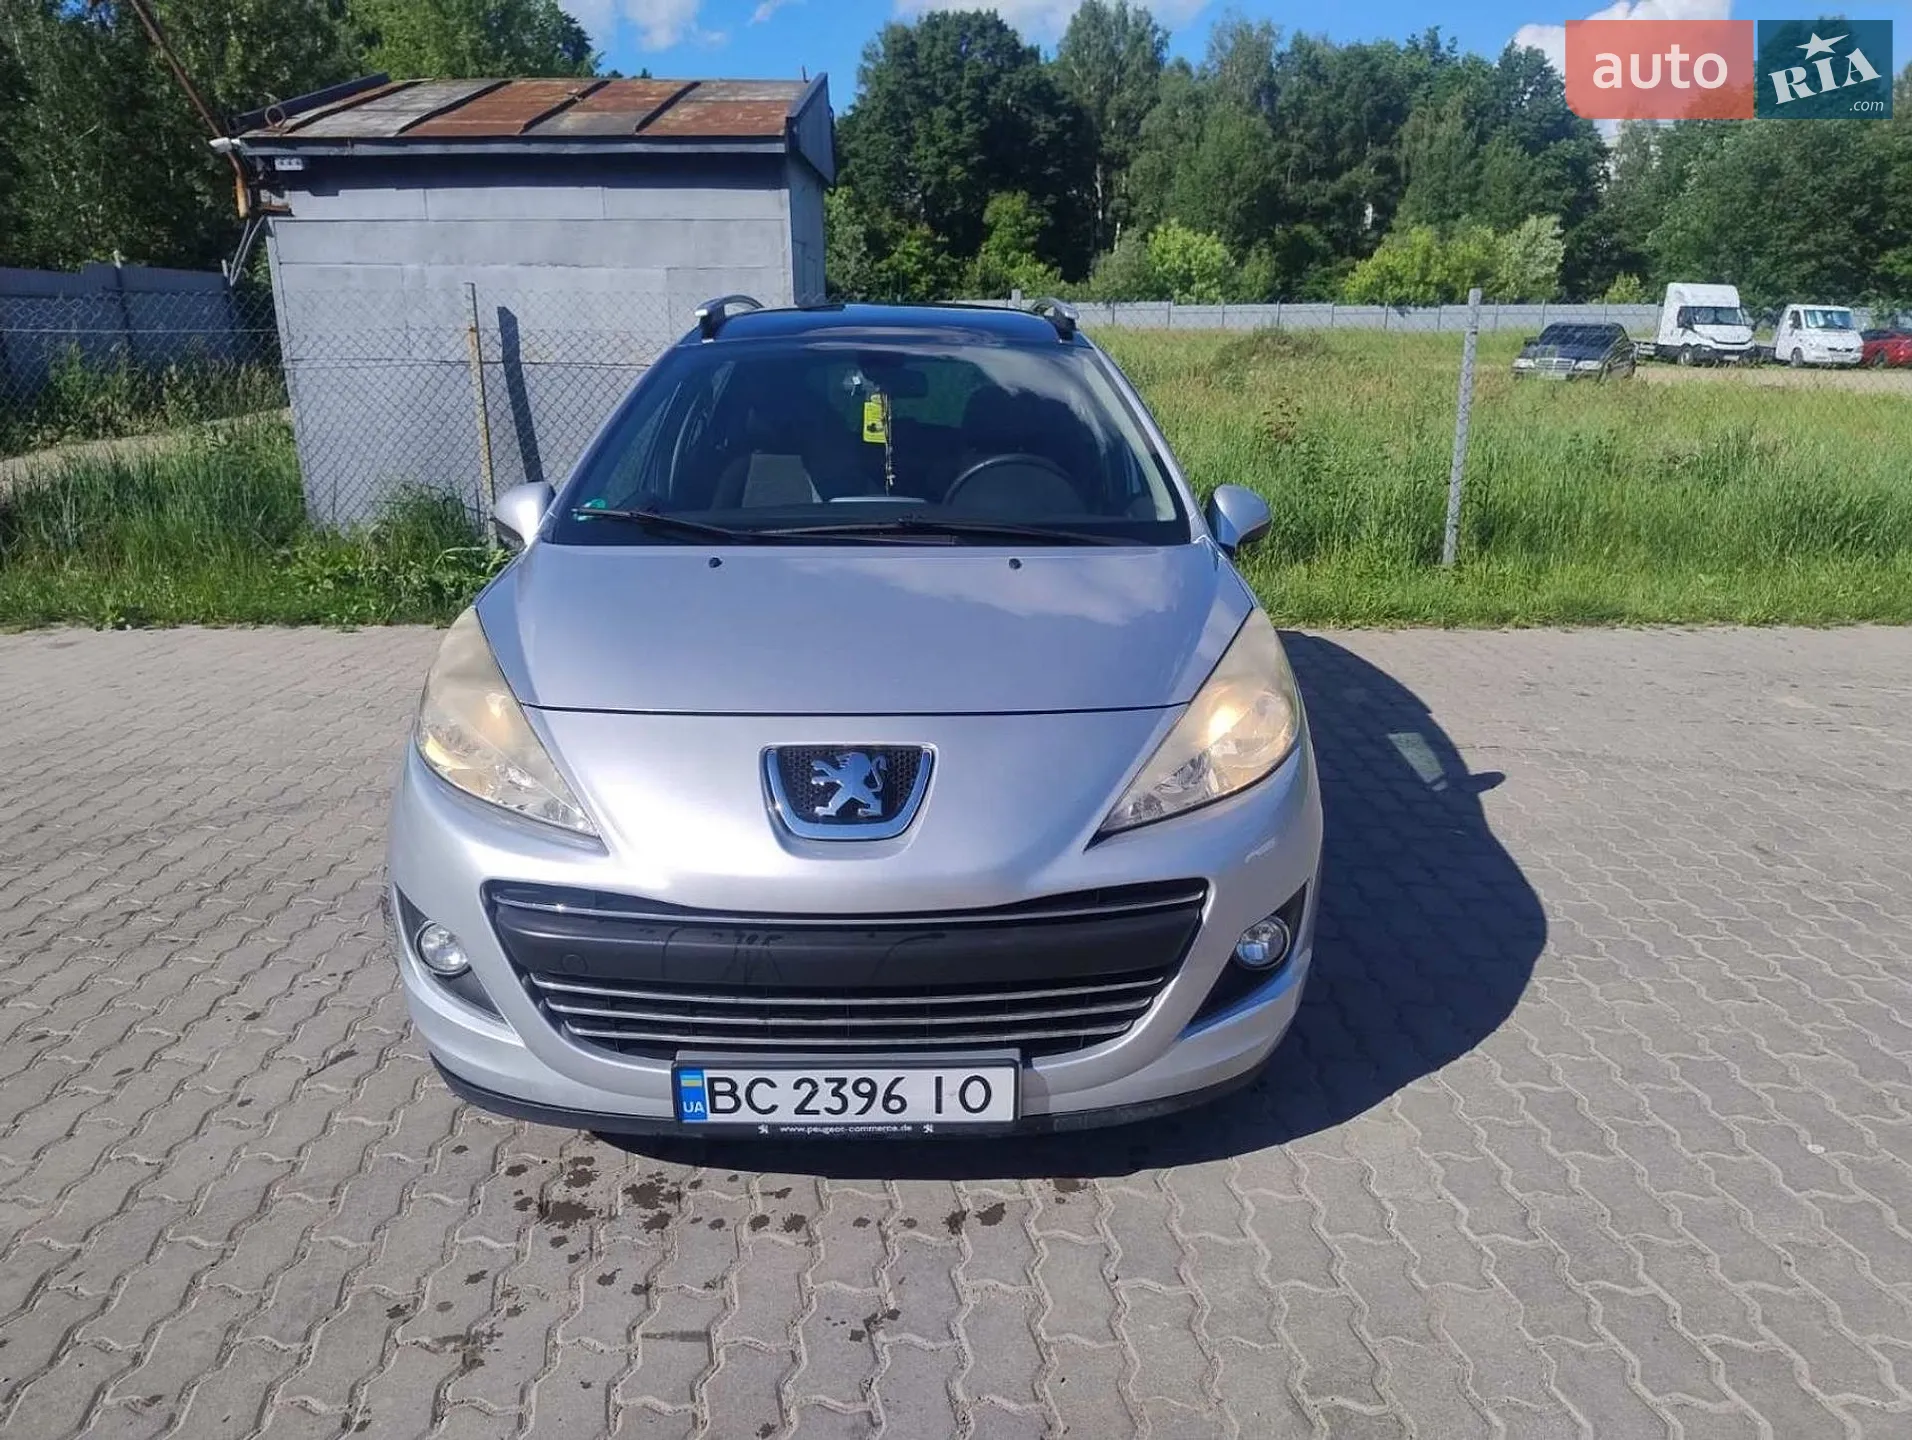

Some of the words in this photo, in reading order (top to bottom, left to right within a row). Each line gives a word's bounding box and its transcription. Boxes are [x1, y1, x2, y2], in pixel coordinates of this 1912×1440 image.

[683, 1101, 706, 1114] UA
[706, 1076, 778, 1115] BC
[793, 1076, 908, 1116] 2396
[935, 1075, 992, 1115] IO
